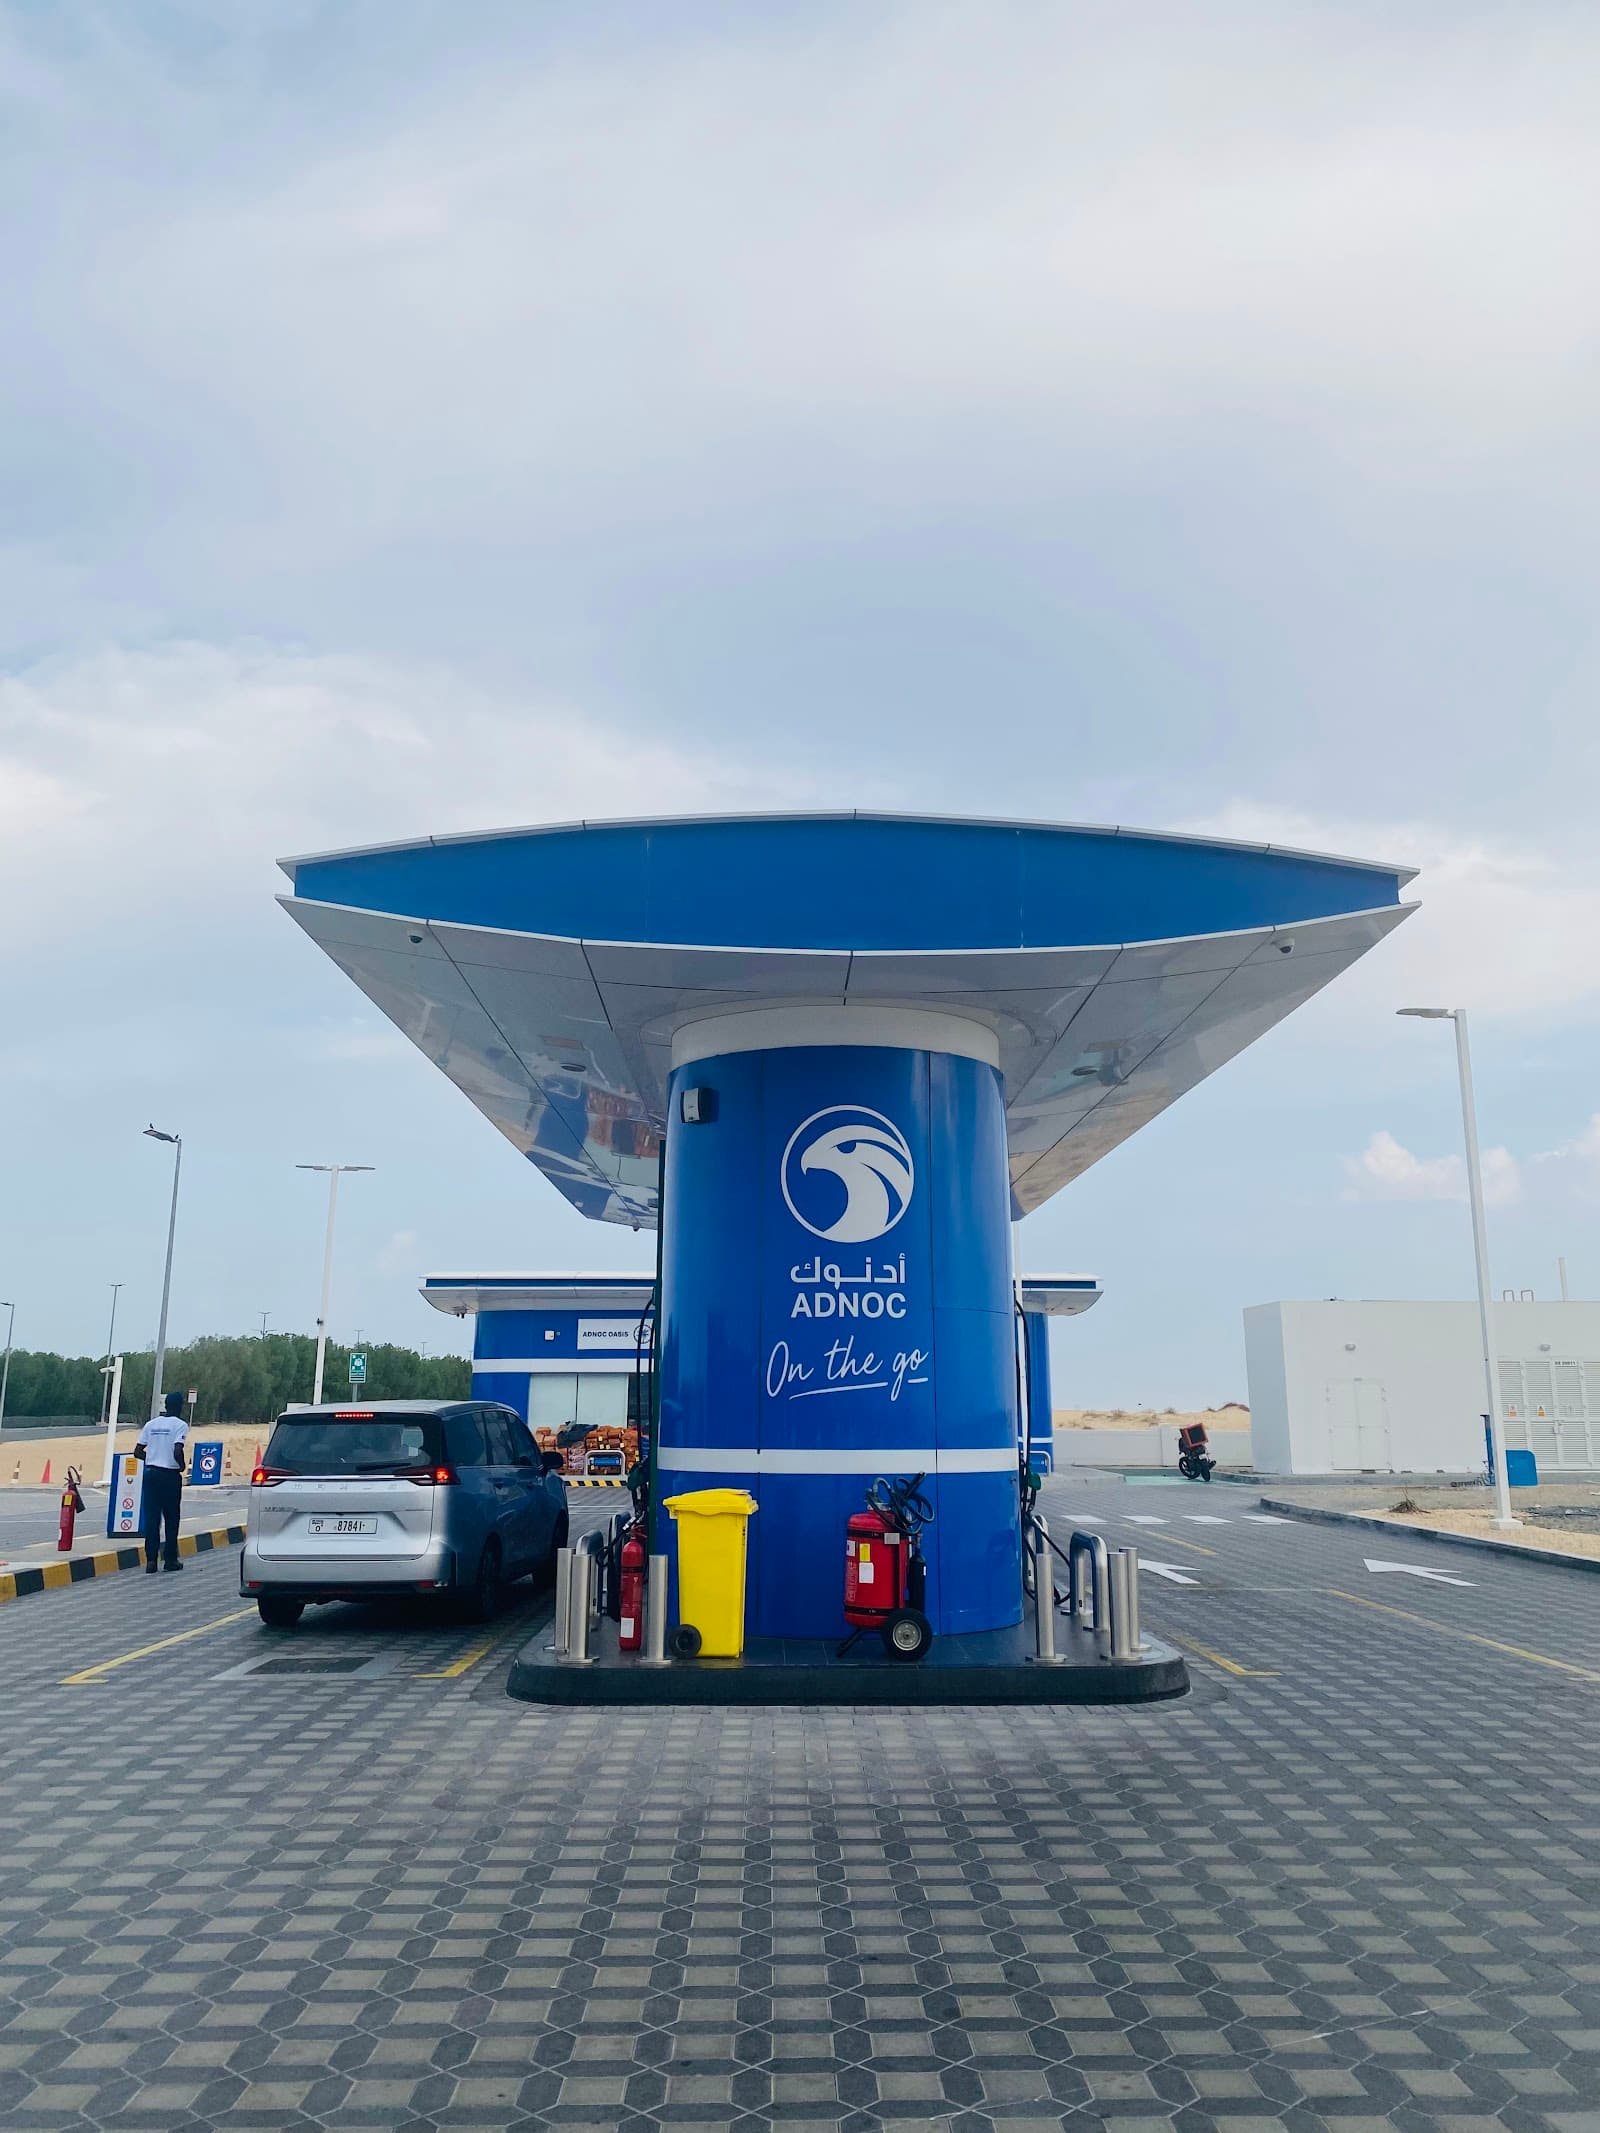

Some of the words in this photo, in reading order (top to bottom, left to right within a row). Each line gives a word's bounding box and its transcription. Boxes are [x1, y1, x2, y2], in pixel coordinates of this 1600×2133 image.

[790, 1253, 906, 1290] أدنوك
[790, 1292, 907, 1319] ADNOC
[766, 1340, 815, 1398] On
[823, 1335, 884, 1381] the
[890, 1348, 930, 1401] go
[337, 1520, 362, 1532] 87841
